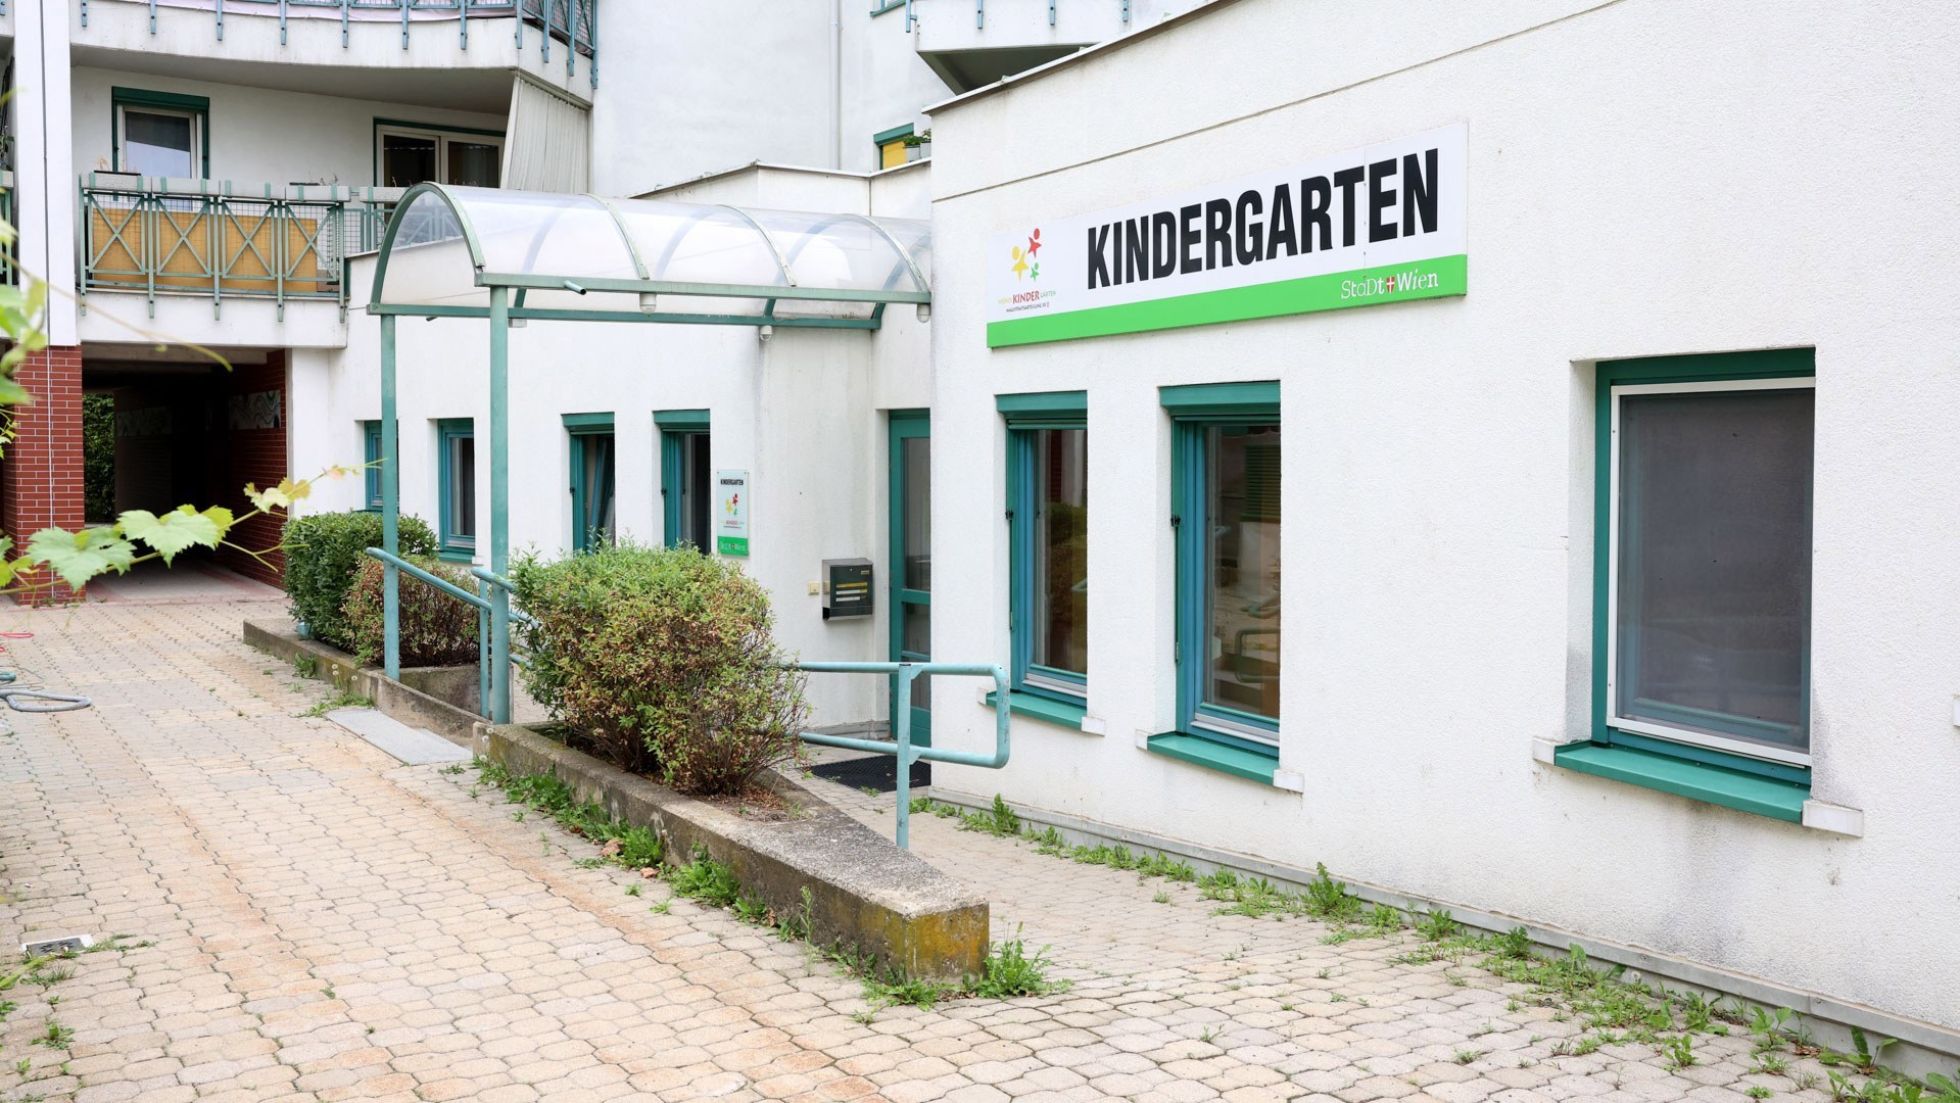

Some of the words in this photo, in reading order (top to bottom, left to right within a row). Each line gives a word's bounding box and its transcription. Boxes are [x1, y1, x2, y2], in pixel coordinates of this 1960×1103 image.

[1088, 148, 1438, 290] KINDERGARTEN
[1396, 268, 1439, 292] Wien
[1012, 290, 1040, 304] KINDER
